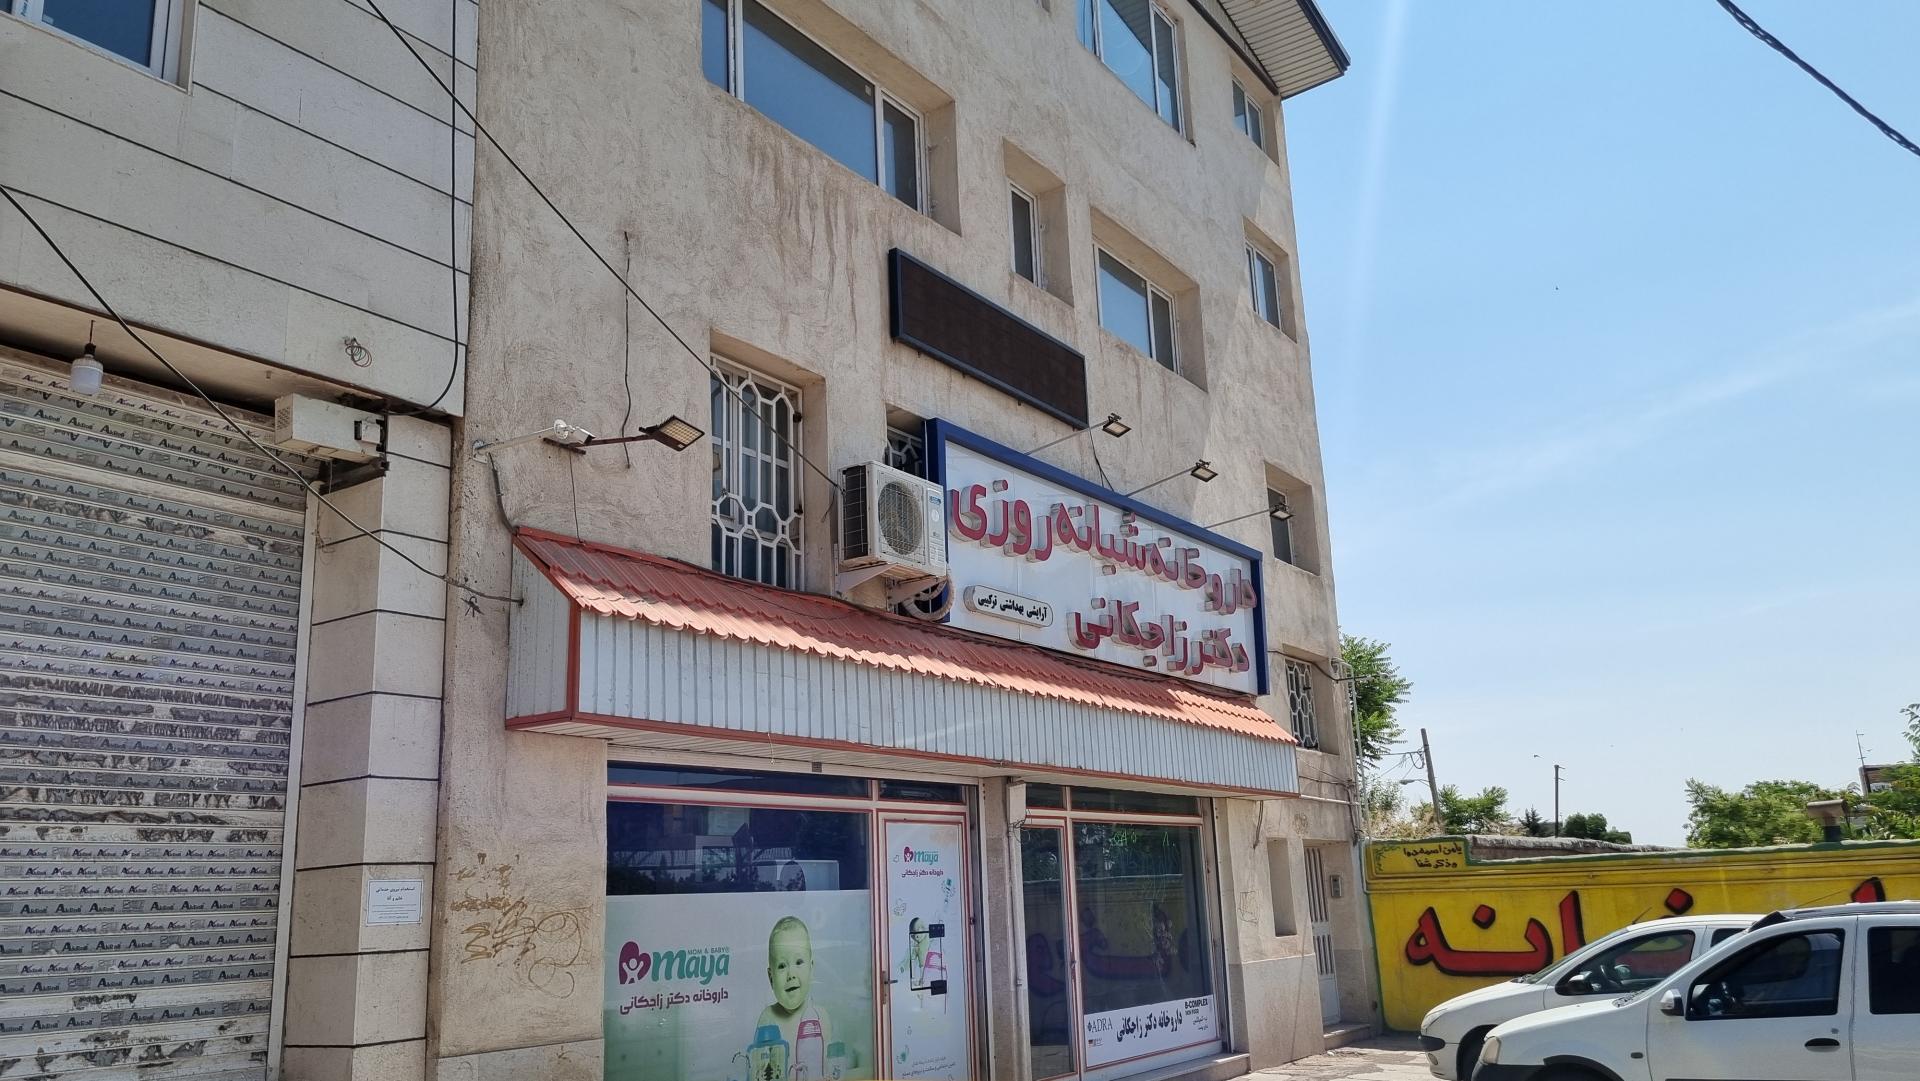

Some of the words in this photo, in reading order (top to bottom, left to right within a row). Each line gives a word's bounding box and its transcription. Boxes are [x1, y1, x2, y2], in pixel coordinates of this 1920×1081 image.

[977, 594, 998, 609] ترکیبی
[1000, 599, 1025, 615] بهداشتی
[1026, 605, 1048, 621] آرایشی
[1067, 597, 1188, 671] زاجکانی
[1184, 628, 1250, 676] دکتر
[651, 950, 730, 985] maya
[619, 993, 663, 1015] زاجکانی
[666, 991, 690, 1009] دکتر
[692, 987, 729, 1003] داروخانه
[1184, 998, 1209, 1010] B-COMPLEX
[1092, 1018, 1113, 1033] ADRA
[1116, 1013, 1142, 1042] زاجکانی
[1144, 1012, 1157, 1037] دکتر
[1158, 1008, 1183, 1032] داروخانه
